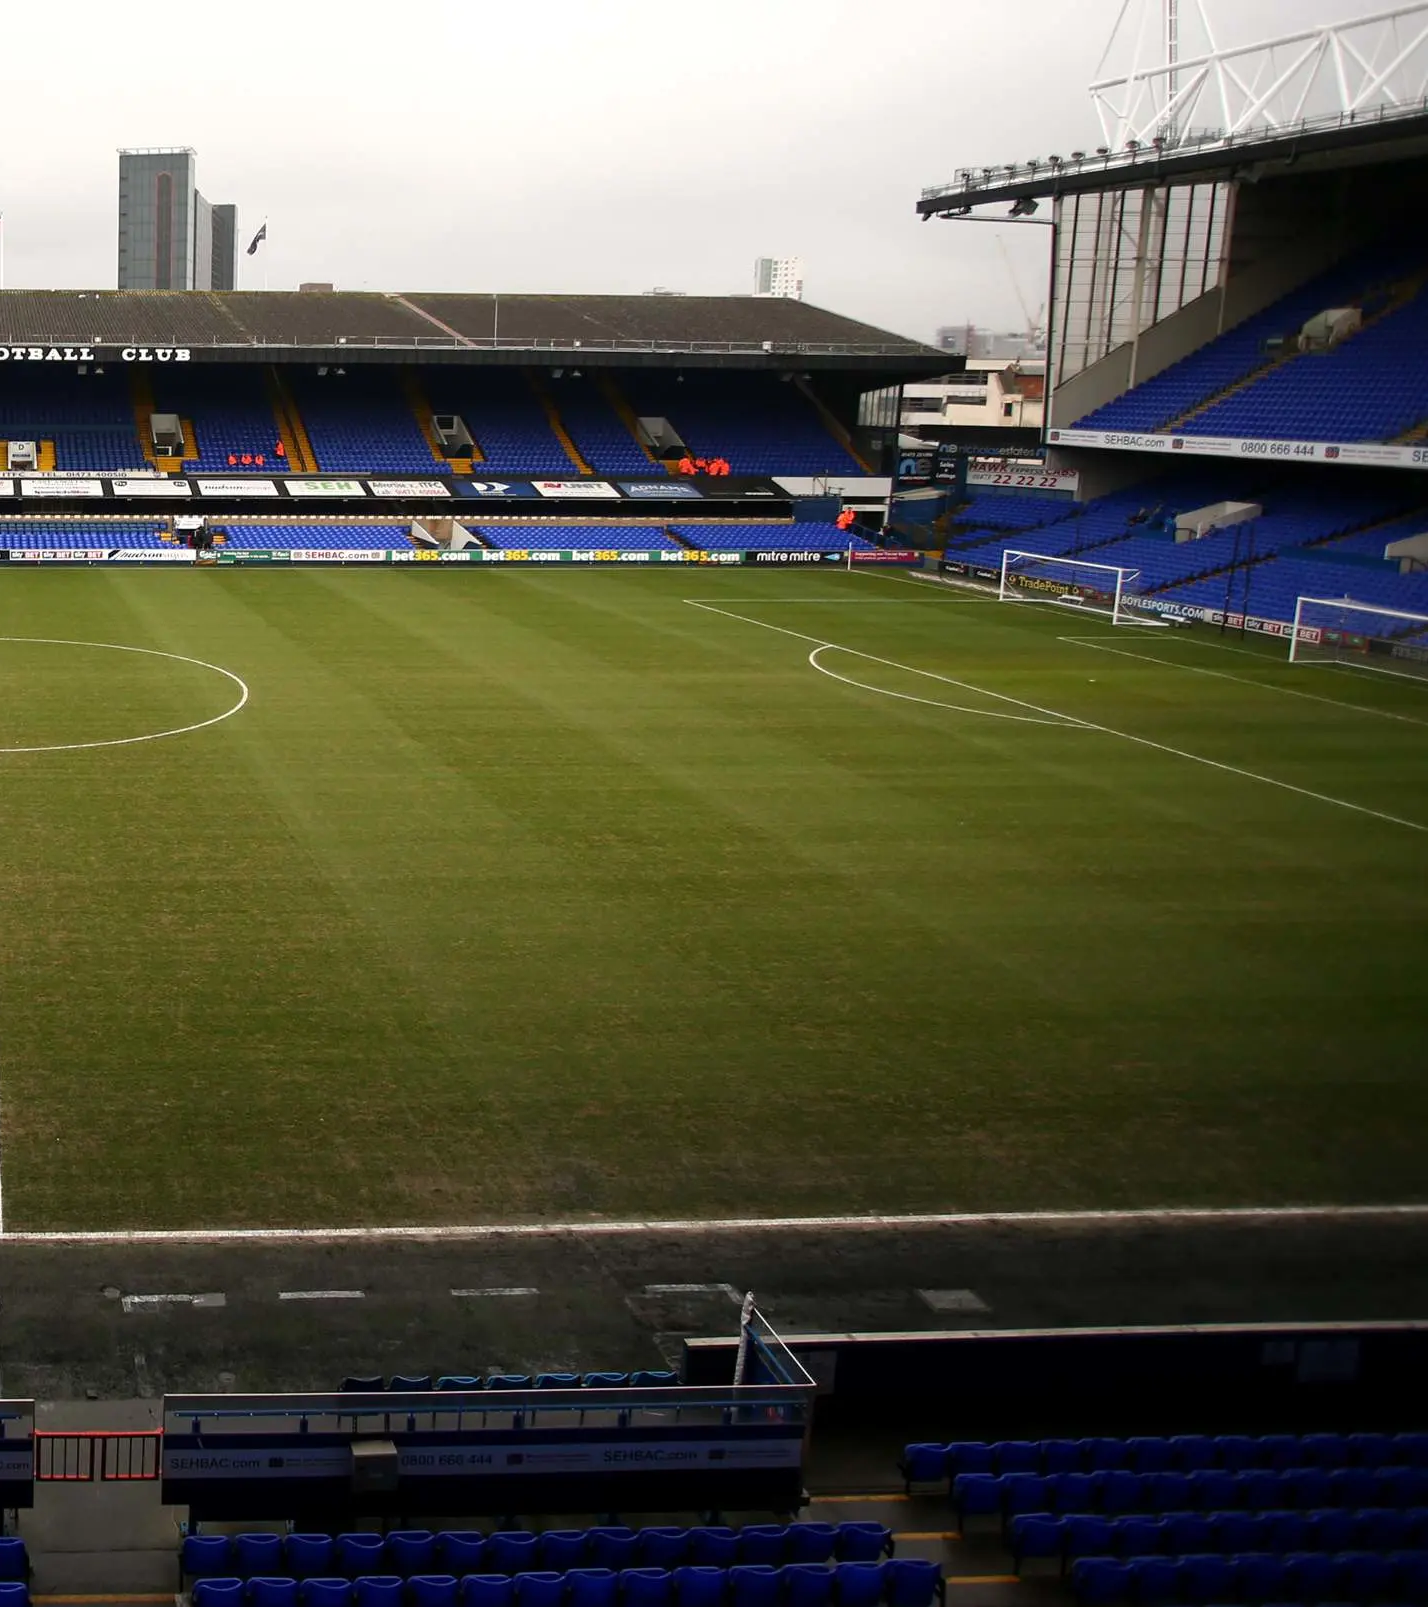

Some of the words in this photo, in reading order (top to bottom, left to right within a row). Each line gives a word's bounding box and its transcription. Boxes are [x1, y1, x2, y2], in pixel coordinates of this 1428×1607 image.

[121, 347, 191, 361] CLUB
[1104, 434, 1165, 448] SEHBAC.com
[1241, 442, 1267, 453] 0800
[1270, 443, 1290, 455] 666
[1293, 444, 1314, 456] 444
[968, 462, 1009, 473] HAWK
[993, 474, 1012, 485] 22
[1015, 475, 1035, 486] 22
[1039, 477, 1058, 488] 22
[630, 484, 693, 493] ADNAMS
[11, 551, 24, 559] sky
[24, 551, 40, 559] BET
[42, 551, 55, 559] sky
[56, 551, 72, 559] BET
[73, 551, 86, 559] sky
[87, 551, 103, 559] BET
[304, 551, 369, 559] SEHBAC.com
[391, 550, 471, 561] bet365.com
[482, 550, 560, 561] bet365.com
[572, 550, 650, 561] bet365.com
[660, 550, 740, 561] bet365.com
[756, 551, 788, 561] mitre
[789, 551, 821, 561] mitre
[1018, 576, 1069, 595] TradePoint
[1120, 596, 1204, 620] BOYLESPORTS.COM
[1227, 616, 1243, 626] BET
[1262, 621, 1280, 632] BET
[1299, 629, 1317, 640] BET
[170, 1457, 261, 1469] SEHBAC.com
[401, 1455, 434, 1467] 0800
[438, 1455, 465, 1466] 666
[467, 1454, 493, 1465] 444
[603, 1449, 698, 1462] SEHBAC.com
